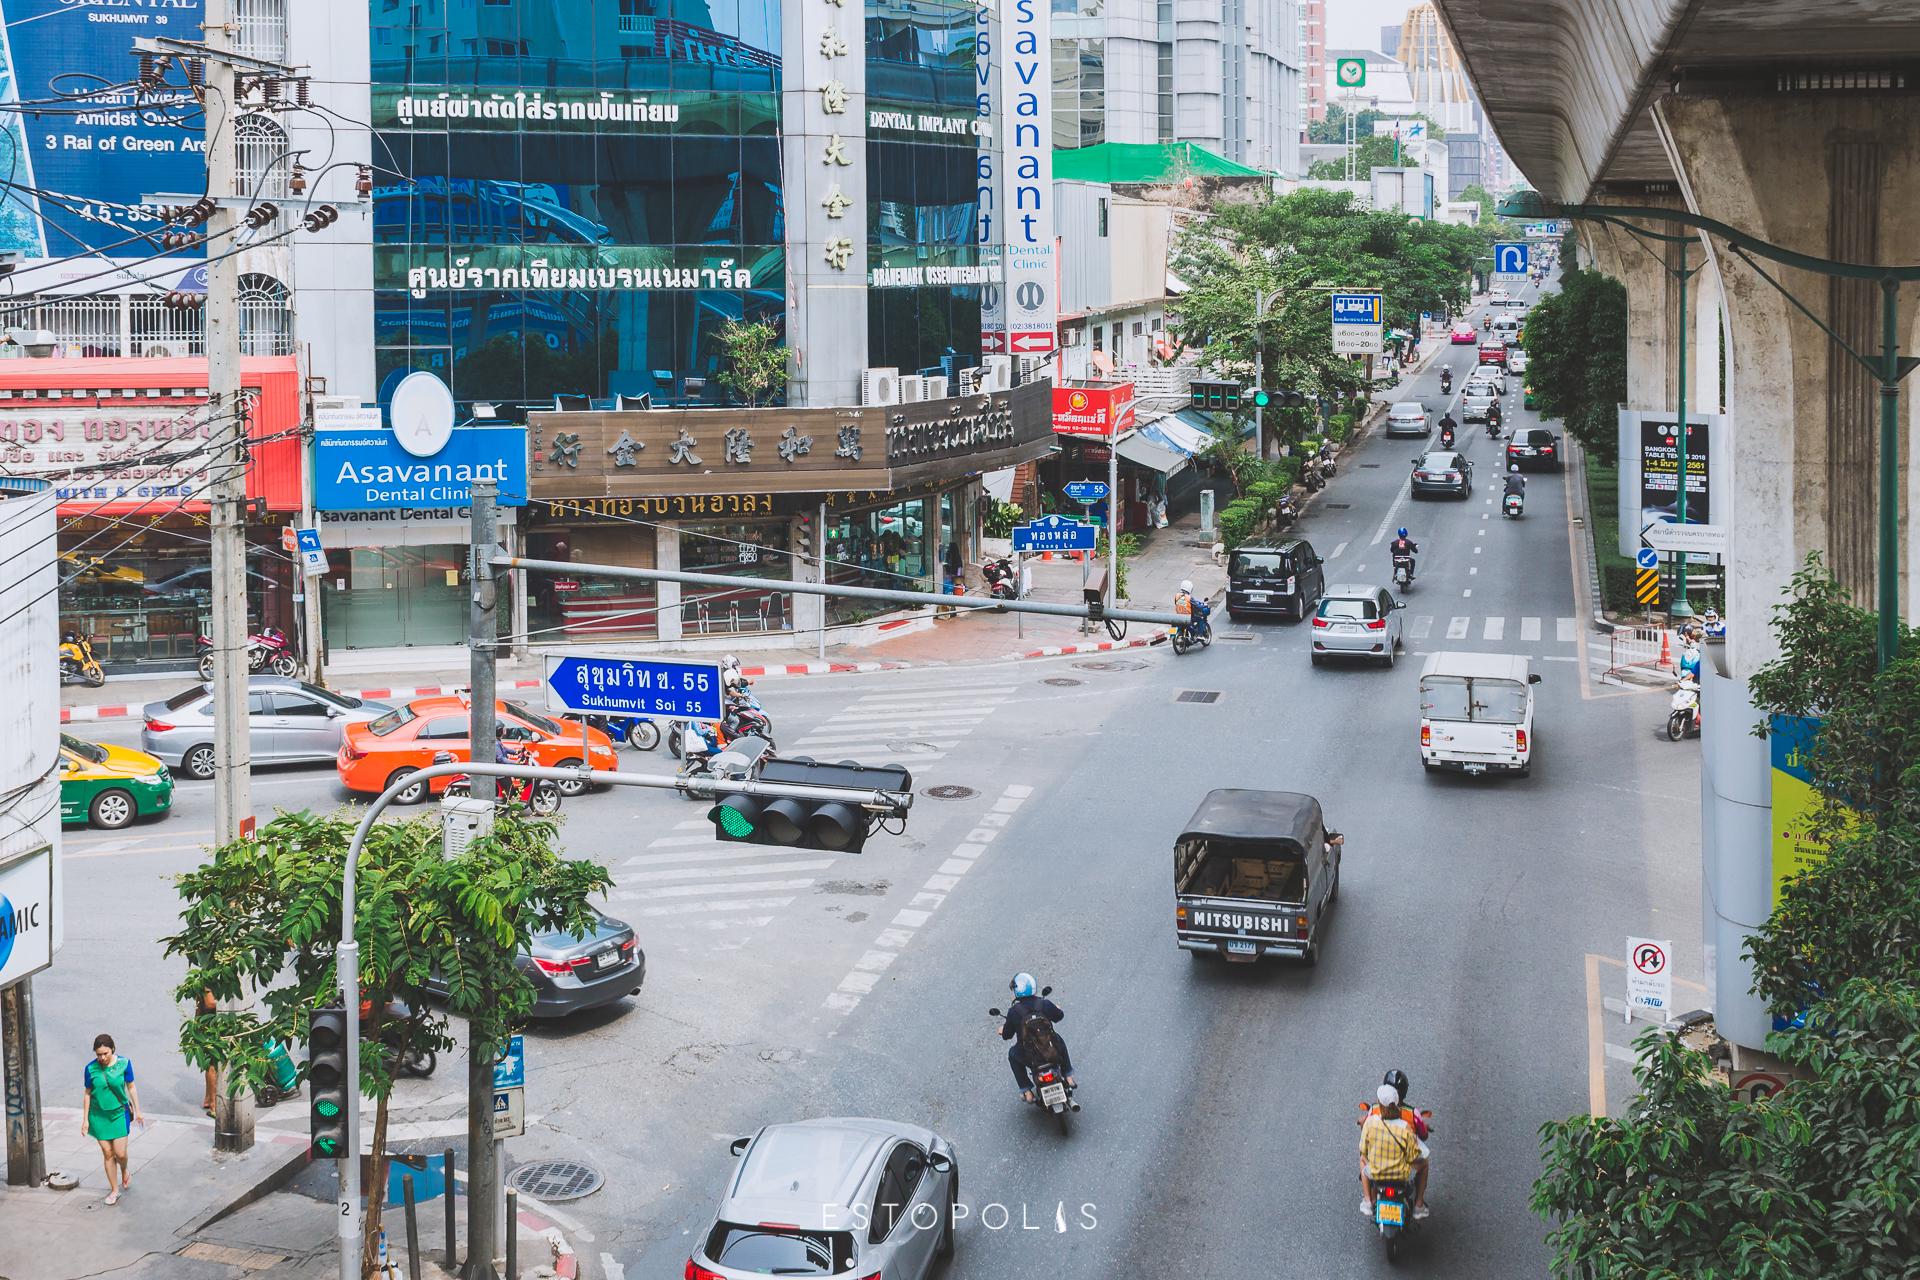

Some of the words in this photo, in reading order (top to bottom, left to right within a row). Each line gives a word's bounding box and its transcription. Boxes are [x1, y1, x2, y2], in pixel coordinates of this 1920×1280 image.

[88, 13, 149, 24] SUKHUMVIT
[156, 15, 168, 25] 39
[397, 91, 679, 125] ศูนย์ผ่าตัดใส่รากฟันเทียม
[76, 112, 137, 127] Amidst
[143, 112, 184, 127] Over
[869, 111, 915, 131] DENTAL
[918, 115, 967, 135] IMPLANT
[46, 135, 57, 149] 3
[64, 136, 92, 150] Rai
[99, 135, 116, 150] of
[123, 136, 175, 151] Green
[1009, 245, 1051, 255] Dental
[1013, 259, 1048, 269] Clinic
[336, 458, 508, 484] Asavanant
[137, 485, 193, 498] GEMS
[366, 487, 425, 502] Dental
[1094, 485, 1104, 494] 55
[401, 506, 454, 521] Dental
[1030, 528, 1077, 541] ทองหล่อ
[576, 662, 651, 692] สุขุมวิท
[683, 672, 709, 692] 55
[582, 694, 646, 710] Sukhumvit
[655, 700, 676, 712] Soi
[686, 701, 702, 713] 55
[1194, 911, 1289, 933] MITSUBISHI
[341, 1202, 350, 1216] 2
